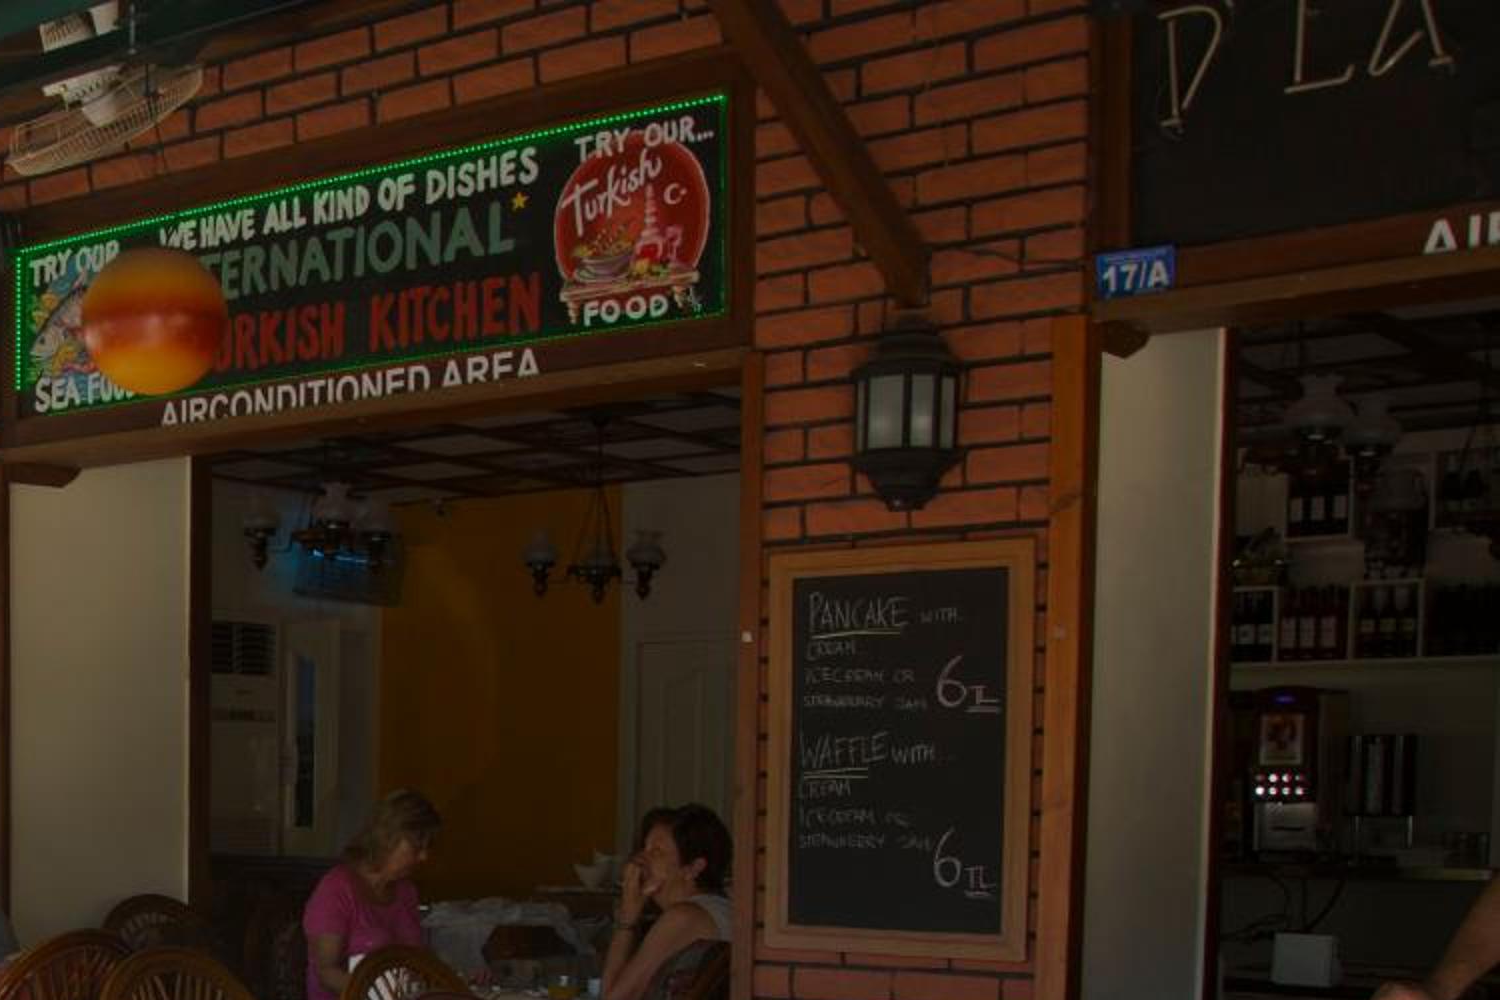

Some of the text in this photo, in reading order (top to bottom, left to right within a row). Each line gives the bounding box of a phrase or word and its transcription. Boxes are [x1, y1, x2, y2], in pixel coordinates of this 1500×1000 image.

[574, 128, 630, 163] TRY
[201, 209, 256, 248] HAVE
[263, 196, 307, 236] ALL
[313, 184, 371, 225] KIND
[377, 173, 417, 212] OF
[425, 146, 541, 206] DISHES
[561, 148, 664, 237] Turkish
[29, 249, 74, 288] TRY
[199, 201, 516, 301] ERNATIONAL
[1102, 259, 1170, 293] 17/A
[213, 271, 544, 374] URKISH KITCHEN
[583, 294, 669, 327] FOOD
[442, 348, 540, 389] AREA
[35, 373, 82, 414] SEA
[808, 591, 910, 631] PANCAKE
[800, 731, 890, 769] WAFFLE
